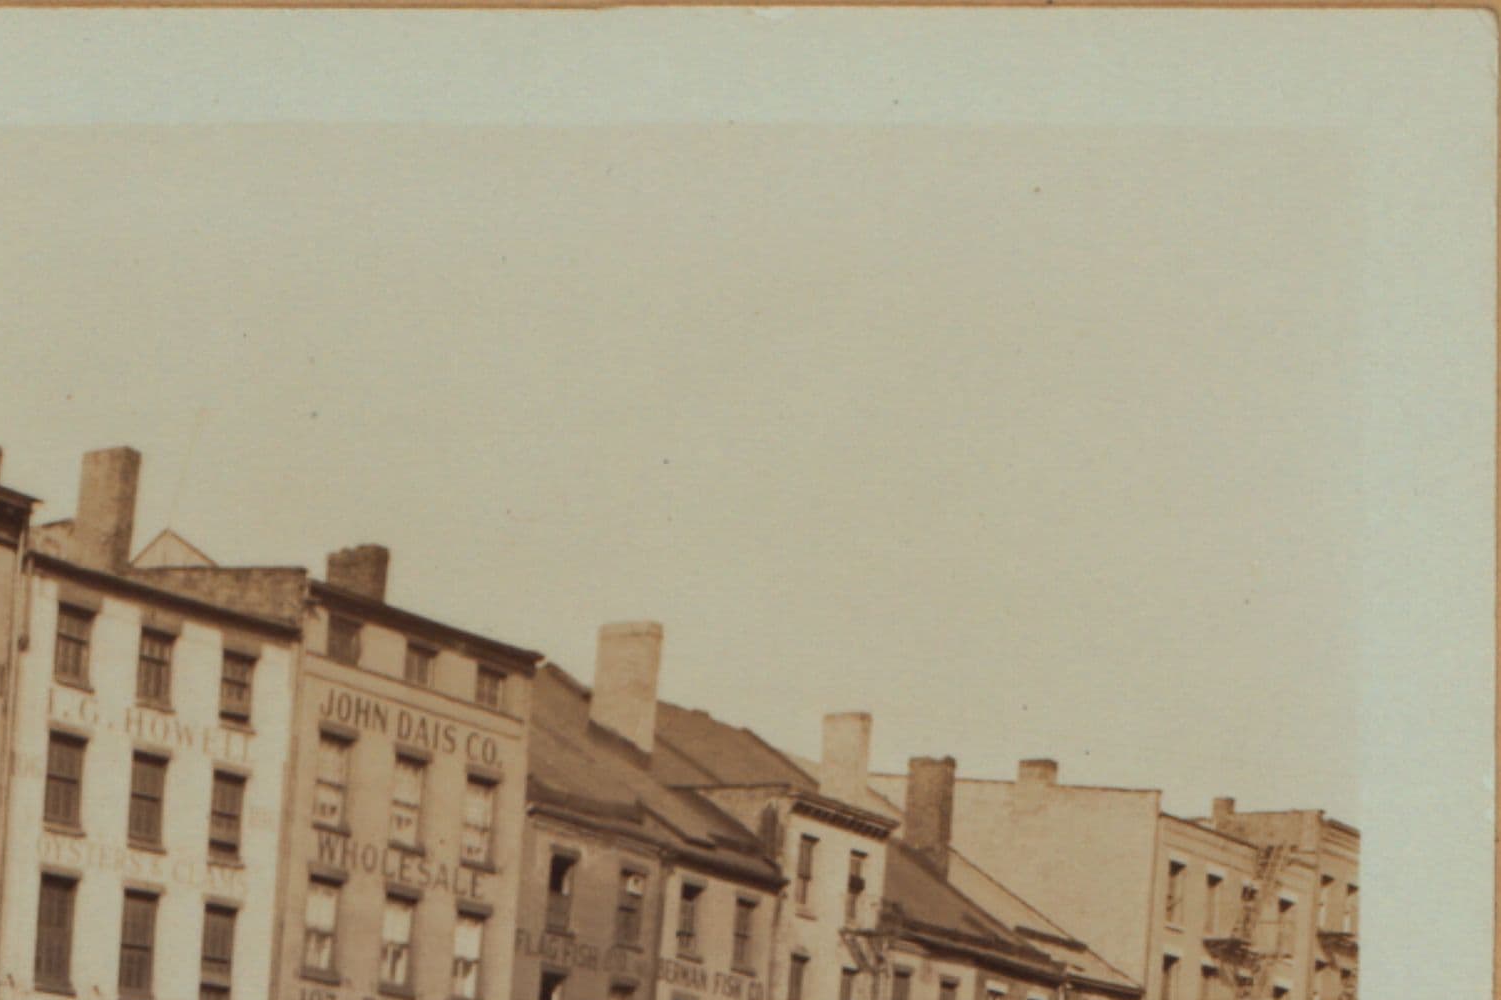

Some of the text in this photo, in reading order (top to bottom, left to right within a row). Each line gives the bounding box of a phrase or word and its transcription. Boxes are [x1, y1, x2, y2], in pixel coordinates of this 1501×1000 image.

[319, 690, 503, 769] JOHN DAIS CO.
[316, 835, 483, 900] WHOLESALE
